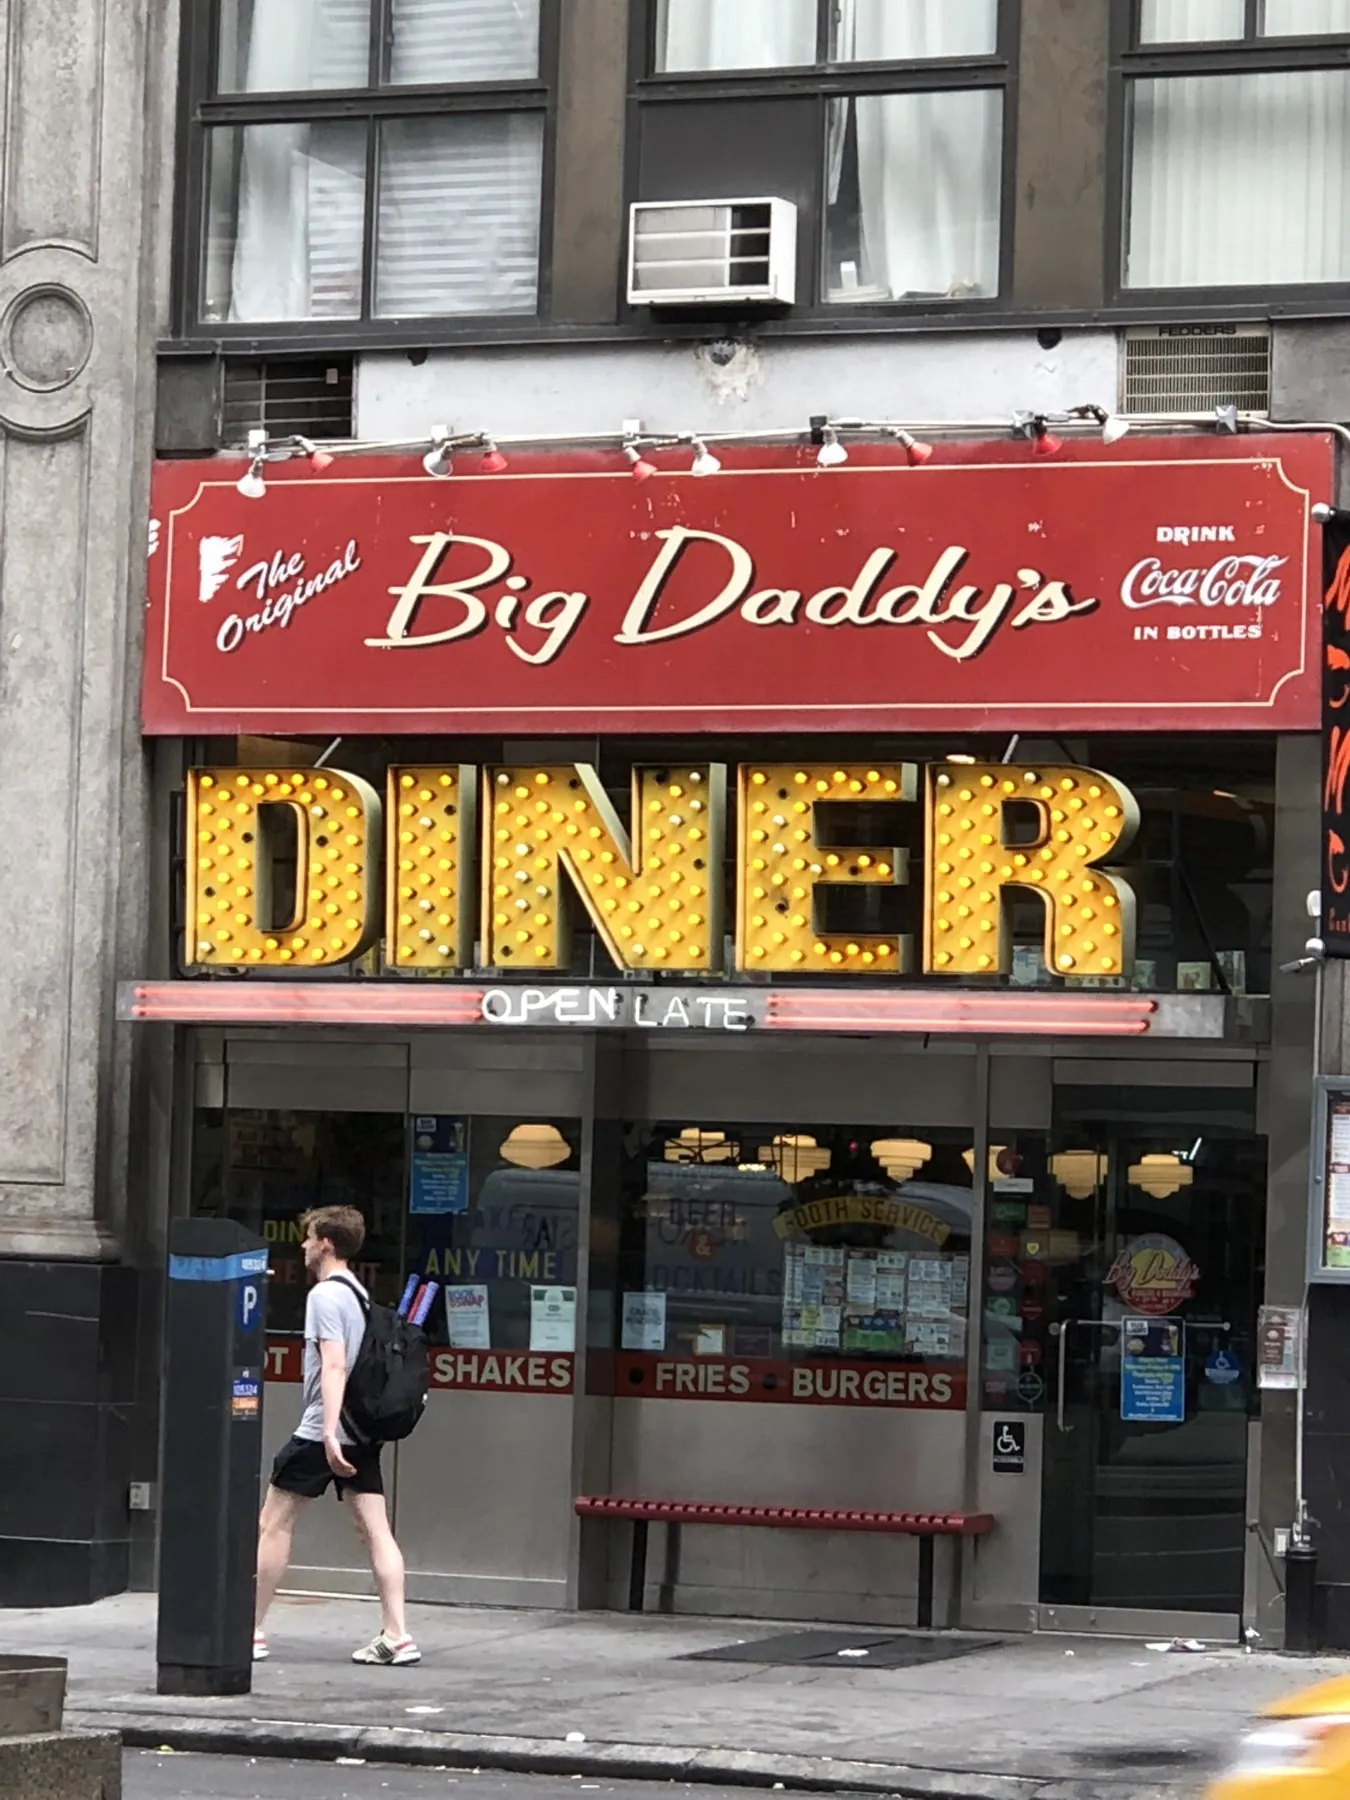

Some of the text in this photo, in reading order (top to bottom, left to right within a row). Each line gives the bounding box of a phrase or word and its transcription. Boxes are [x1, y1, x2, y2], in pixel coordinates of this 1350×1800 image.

[1158, 324, 1237, 337] FEDDERS
[1156, 525, 1236, 546] DRINK
[217, 540, 362, 653] Original
[236, 552, 305, 600] The
[364, 525, 1097, 665] Big Daddy's
[1133, 624, 1263, 641] IN BOTTLES
[185, 762, 1140, 977] DINER
[481, 987, 749, 1031] OPEN LATE
[860, 1199, 946, 1240] SERVICE
[424, 1247, 557, 1281] ANY TIME
[650, 1264, 783, 1295] OCKTAILS
[243, 1284, 259, 1325] P
[432, 1353, 571, 1388] SHAKES
[655, 1362, 953, 1403] FRIES BURGERS
